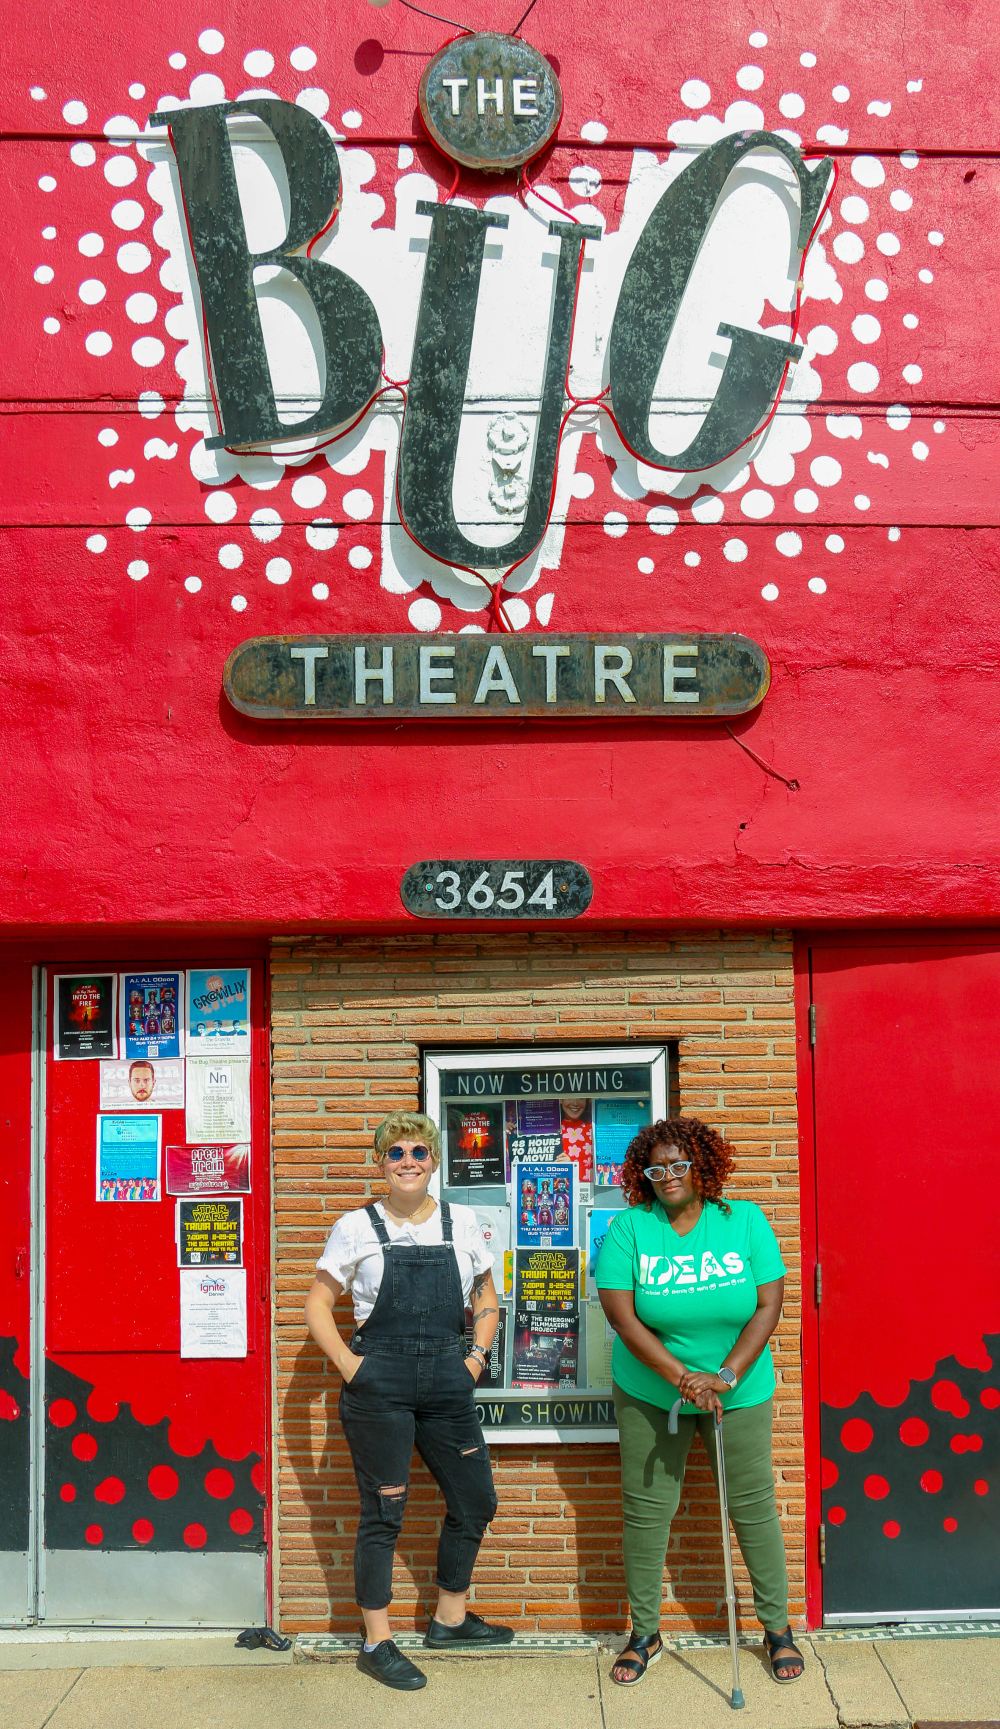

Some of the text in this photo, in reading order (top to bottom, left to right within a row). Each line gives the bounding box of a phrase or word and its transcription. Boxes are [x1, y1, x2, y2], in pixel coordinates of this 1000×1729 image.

[441, 76, 540, 119] THE
[149, 98, 837, 569] BUG
[290, 645, 700, 705] THEATRE
[434, 870, 558, 911] 3654
[208, 979, 222, 990] THE
[192, 980, 247, 1010] GR@WLIX
[209, 1071, 228, 1084] Nn
[457, 1070, 624, 1096] NOW SHOWING
[511, 1137, 561, 1148] 48 HOURS
[511, 1146, 555, 1156] TO MAKE
[512, 1153, 554, 1163] A MOVIE
[192, 1204, 230, 1214] STAR
[192, 1211, 230, 1222] WARS
[184, 1221, 238, 1231] TRIVIA NIGHT
[528, 1252, 567, 1262] STAR
[528, 1260, 567, 1271] WARS
[638, 1250, 745, 1286] IDEAS
[520, 1270, 576, 1279] TRIVIA NIGHT
[200, 1282, 226, 1294] Ignite
[530, 1321, 569, 1329] FILMMAKERS
[544, 1316, 576, 1324] EMERGING
[476, 1402, 618, 1424] OW SHOWIN
